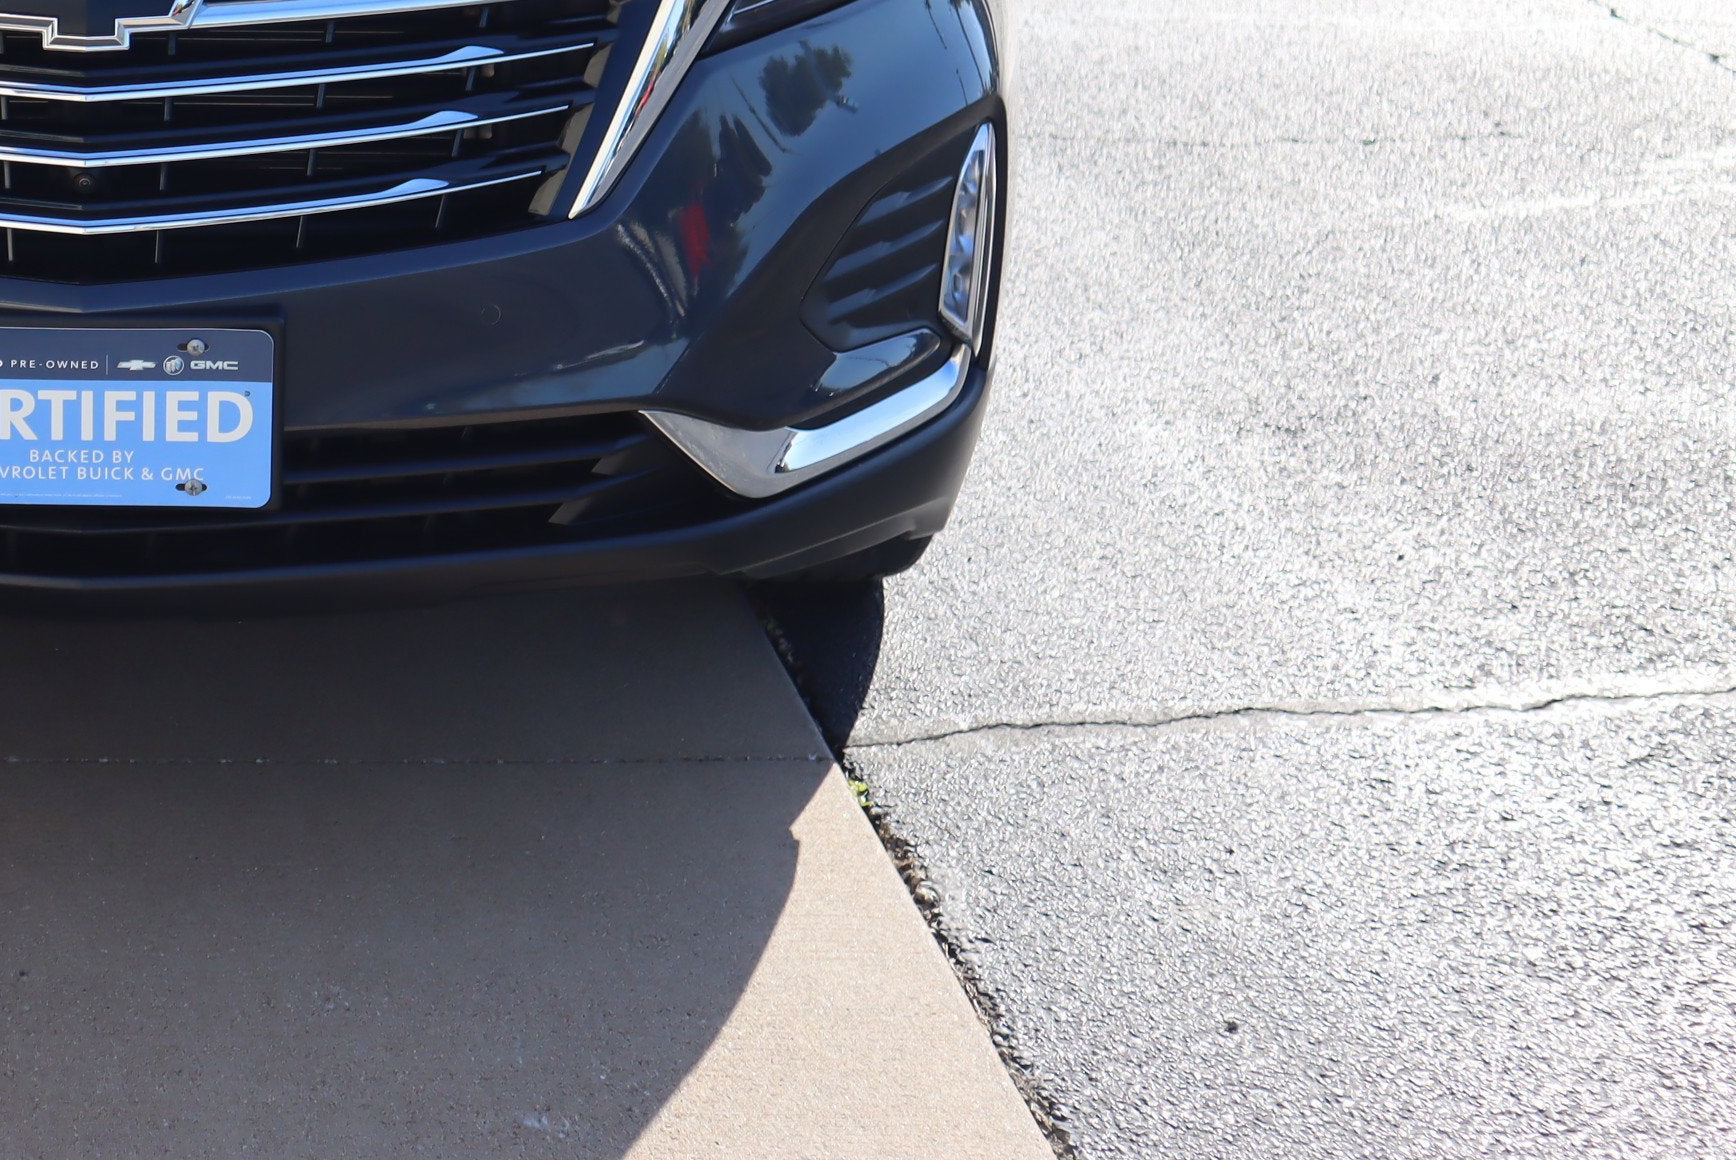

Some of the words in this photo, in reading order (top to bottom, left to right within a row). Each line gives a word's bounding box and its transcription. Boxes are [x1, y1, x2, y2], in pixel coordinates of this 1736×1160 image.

[10, 359, 100, 370] PRE-OWNED
[190, 360, 239, 371] GMC
[29, 449, 104, 464] BACKED
[112, 450, 134, 464] BY
[77, 467, 134, 481] BUICK
[141, 468, 154, 481] &
[161, 467, 204, 482] GMC
